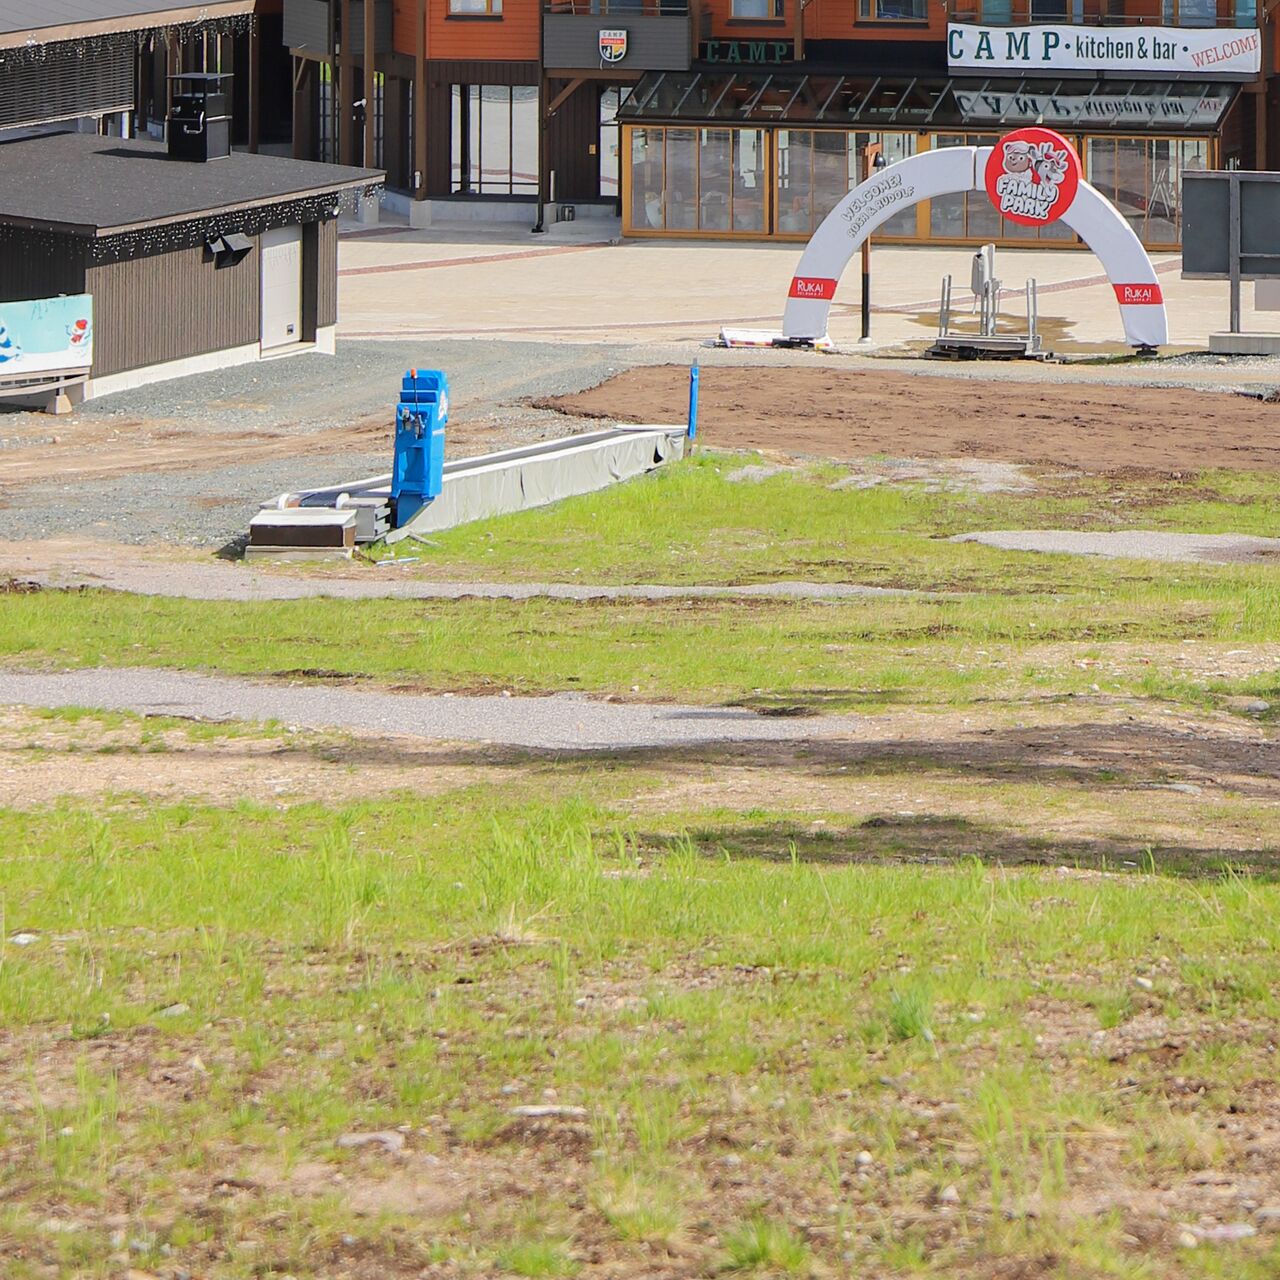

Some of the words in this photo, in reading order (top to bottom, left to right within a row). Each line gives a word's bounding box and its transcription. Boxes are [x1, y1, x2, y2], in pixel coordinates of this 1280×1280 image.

[706, 40, 788, 64] CAMP
[949, 29, 1060, 60] CAMP
[1076, 35, 1134, 59] kitchen
[1137, 36, 1148, 59] &
[1153, 36, 1178, 60] bar
[998, 179, 1058, 203] FAMILY
[1001, 194, 1049, 218] PARK
